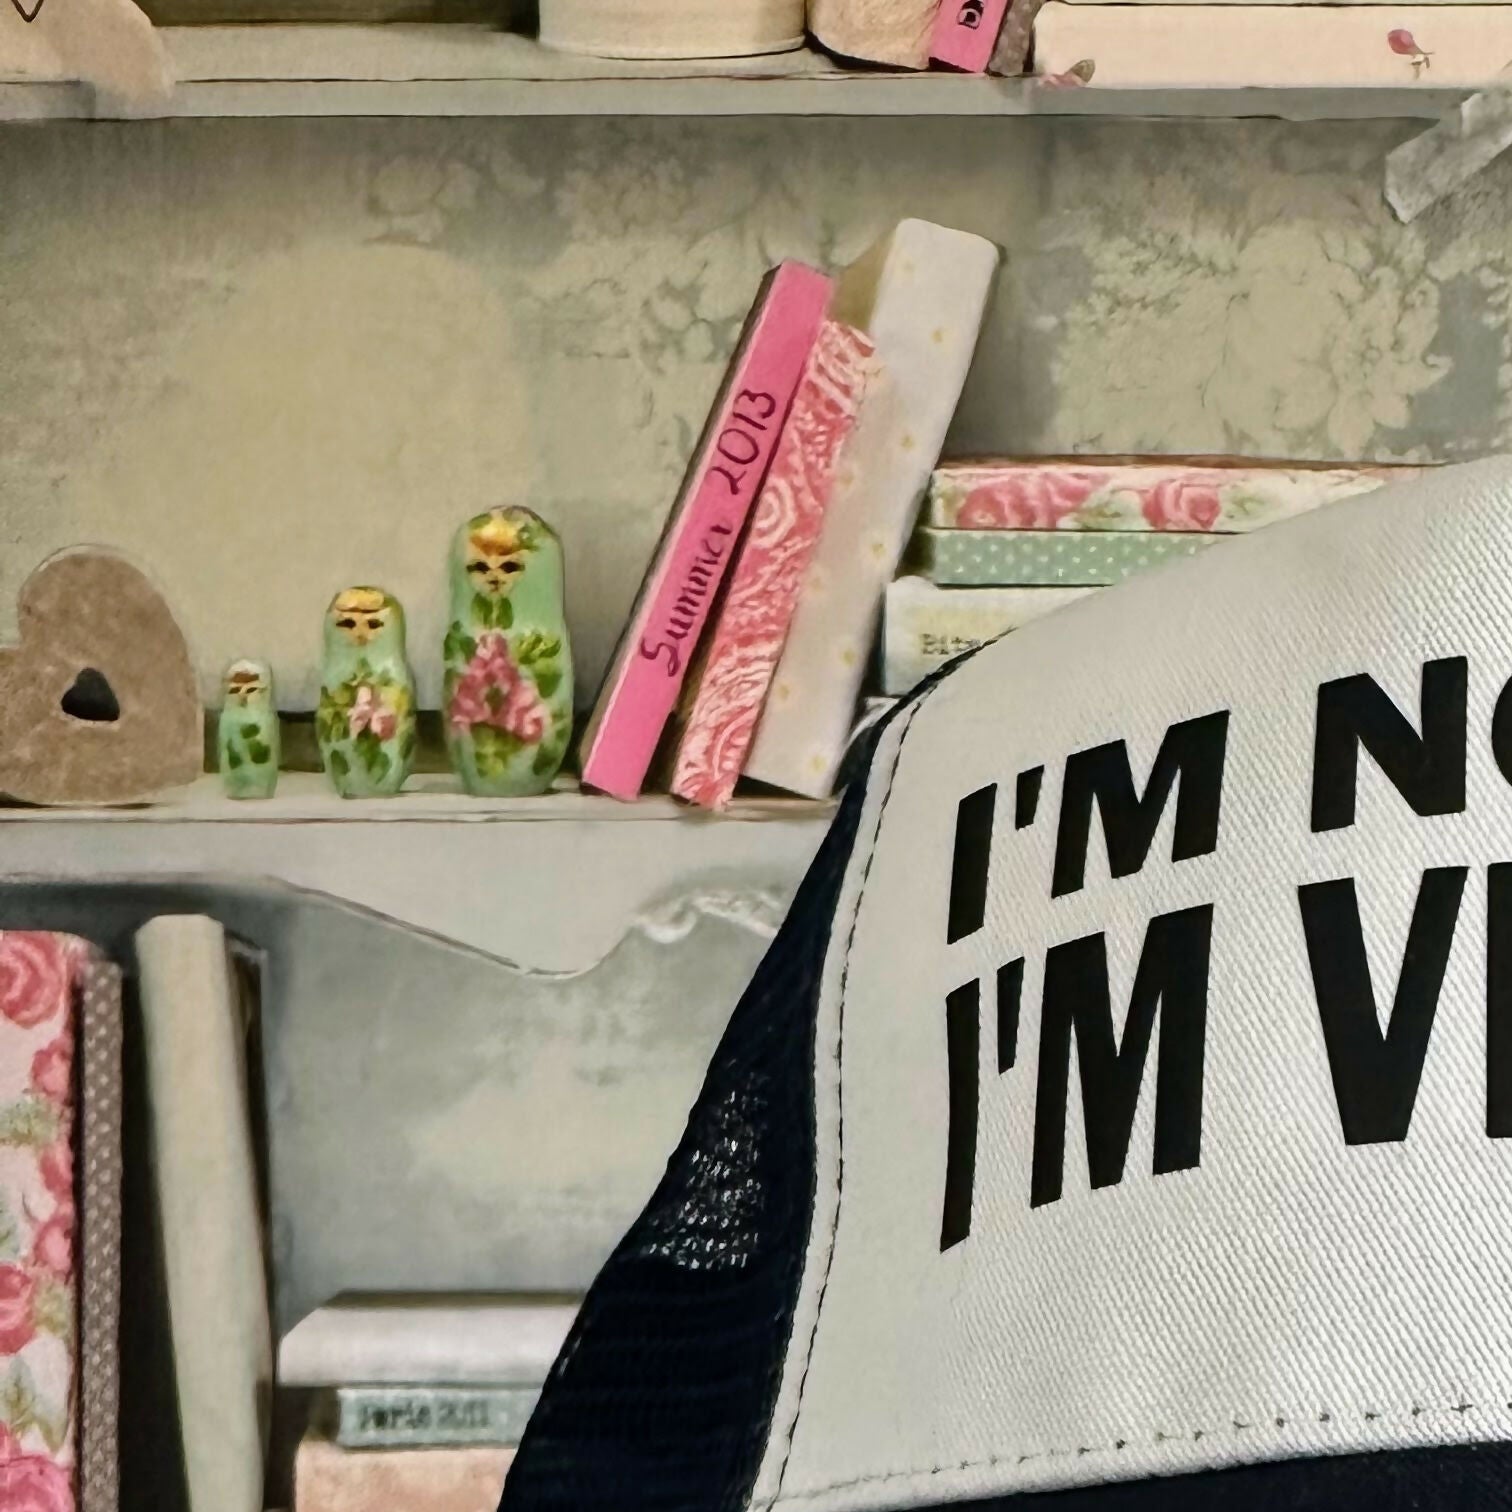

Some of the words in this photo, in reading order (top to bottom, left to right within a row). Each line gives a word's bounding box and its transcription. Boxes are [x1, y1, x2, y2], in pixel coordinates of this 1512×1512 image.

[640, 523, 733, 678] Summer
[711, 389, 777, 497] 2013
[946, 708, 1231, 945] I'M
[939, 902, 1215, 1254] I'M
